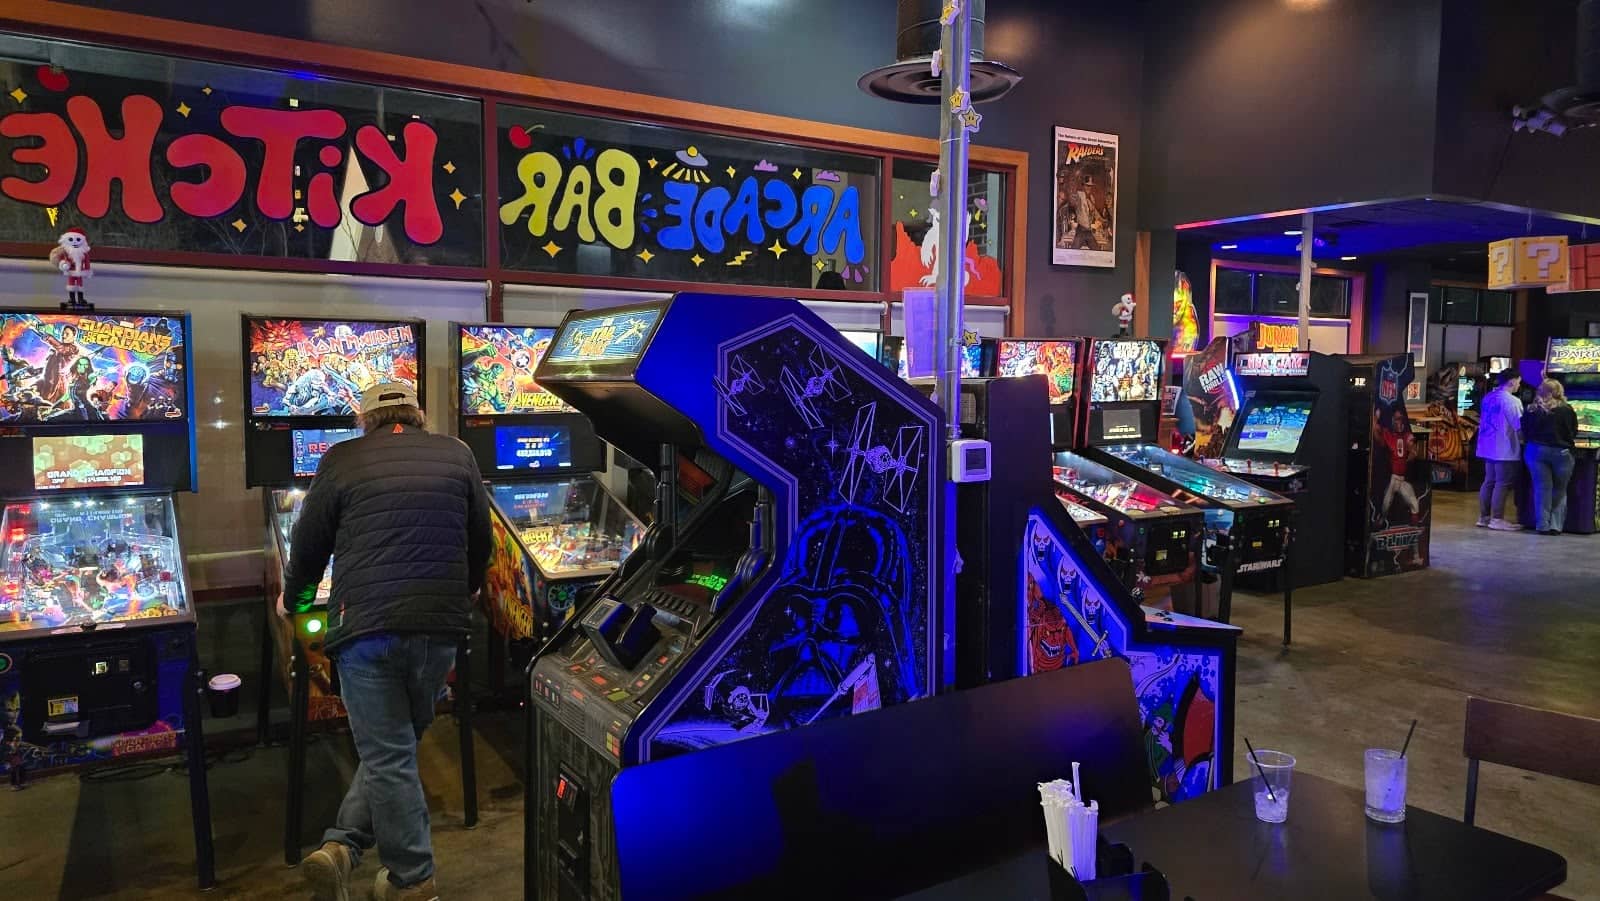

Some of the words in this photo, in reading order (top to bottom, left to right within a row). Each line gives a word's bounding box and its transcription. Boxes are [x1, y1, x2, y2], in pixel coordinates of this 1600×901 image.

[78, 318, 172, 348] GUARDIANS
[97, 333, 166, 355] GALAXY
[297, 336, 345, 360] IRON
[345, 325, 414, 351] MAIDEN
[1247, 356, 1269, 369] NBA
[1277, 355, 1302, 369] JAM
[511, 392, 564, 407] AVENGERS
[47, 469, 79, 479] GRAND
